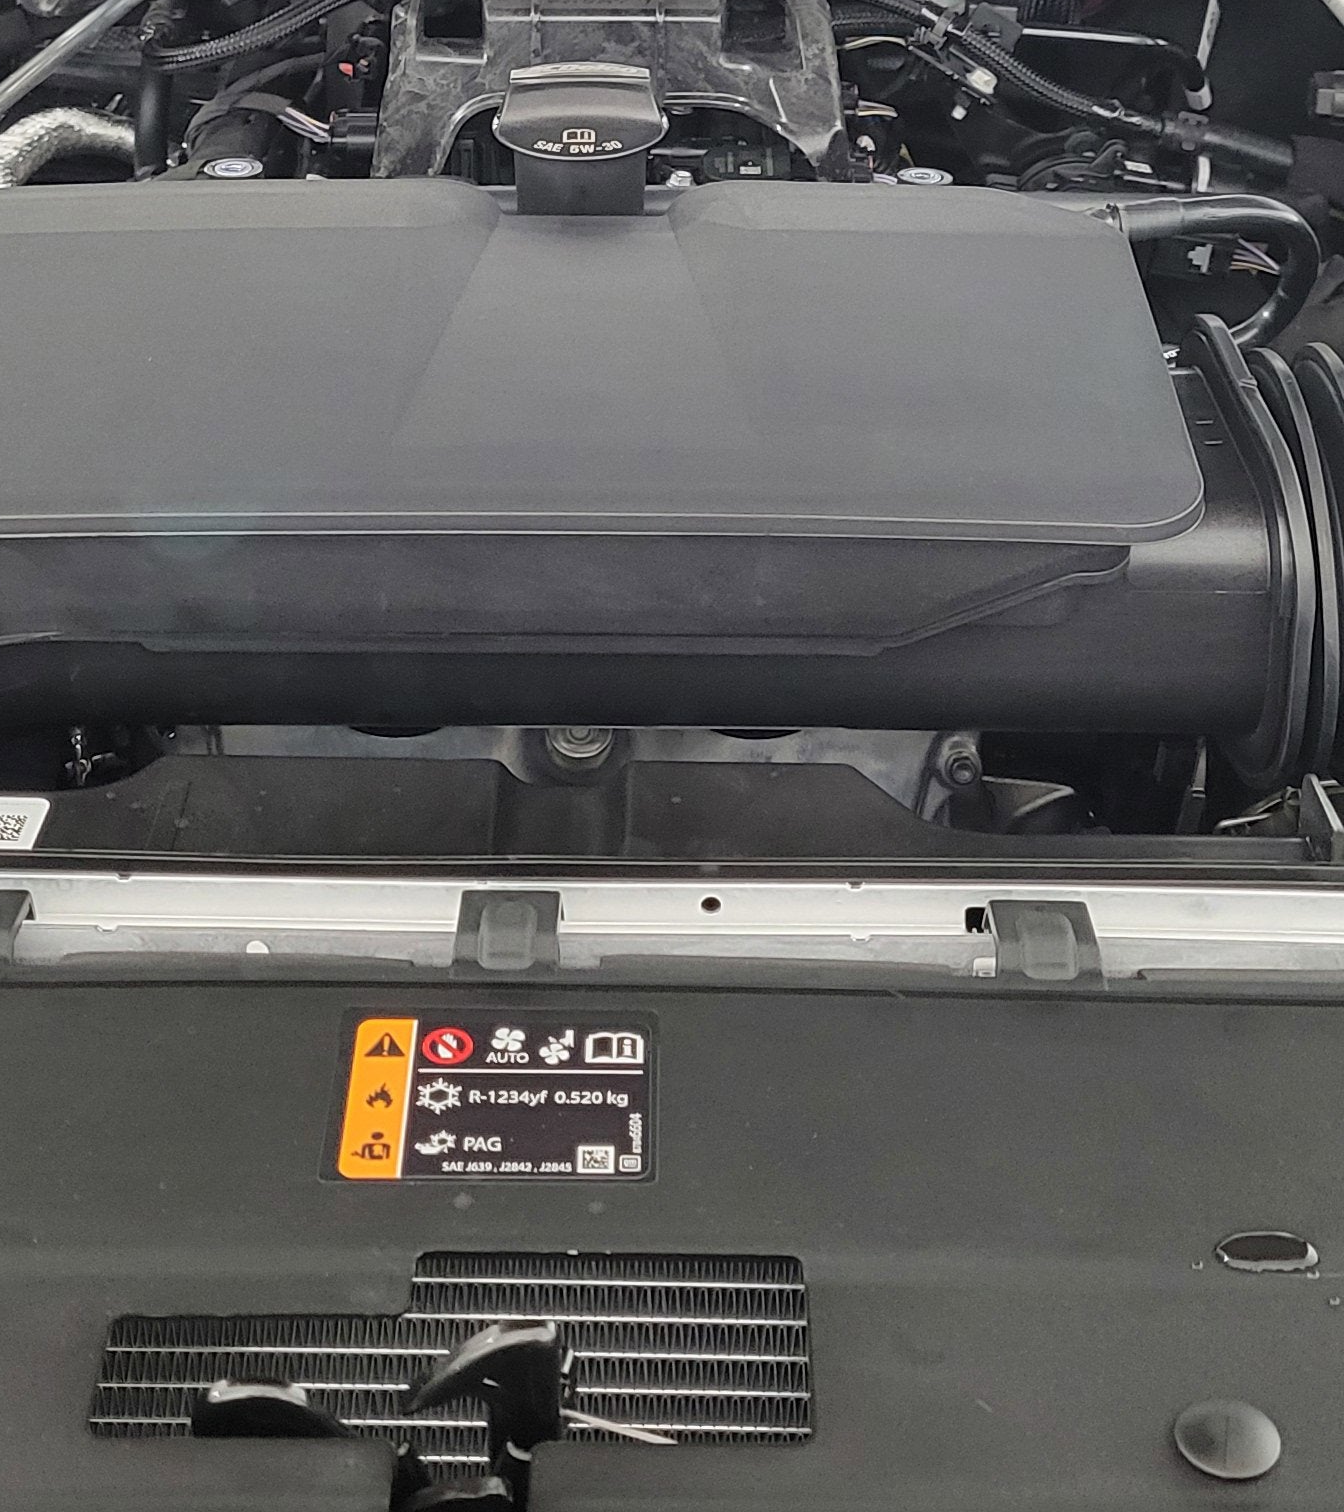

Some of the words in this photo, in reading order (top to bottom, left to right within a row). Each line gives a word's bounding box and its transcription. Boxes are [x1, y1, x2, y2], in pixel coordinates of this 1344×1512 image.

[533, 140, 564, 153] SAE
[485, 1051, 530, 1064] AUTO
[468, 1089, 549, 1107] R-1234yf
[554, 1090, 604, 1105] 0.520
[607, 1090, 629, 1108] kg
[463, 1136, 502, 1152] PAG
[441, 1161, 464, 1173] SAE
